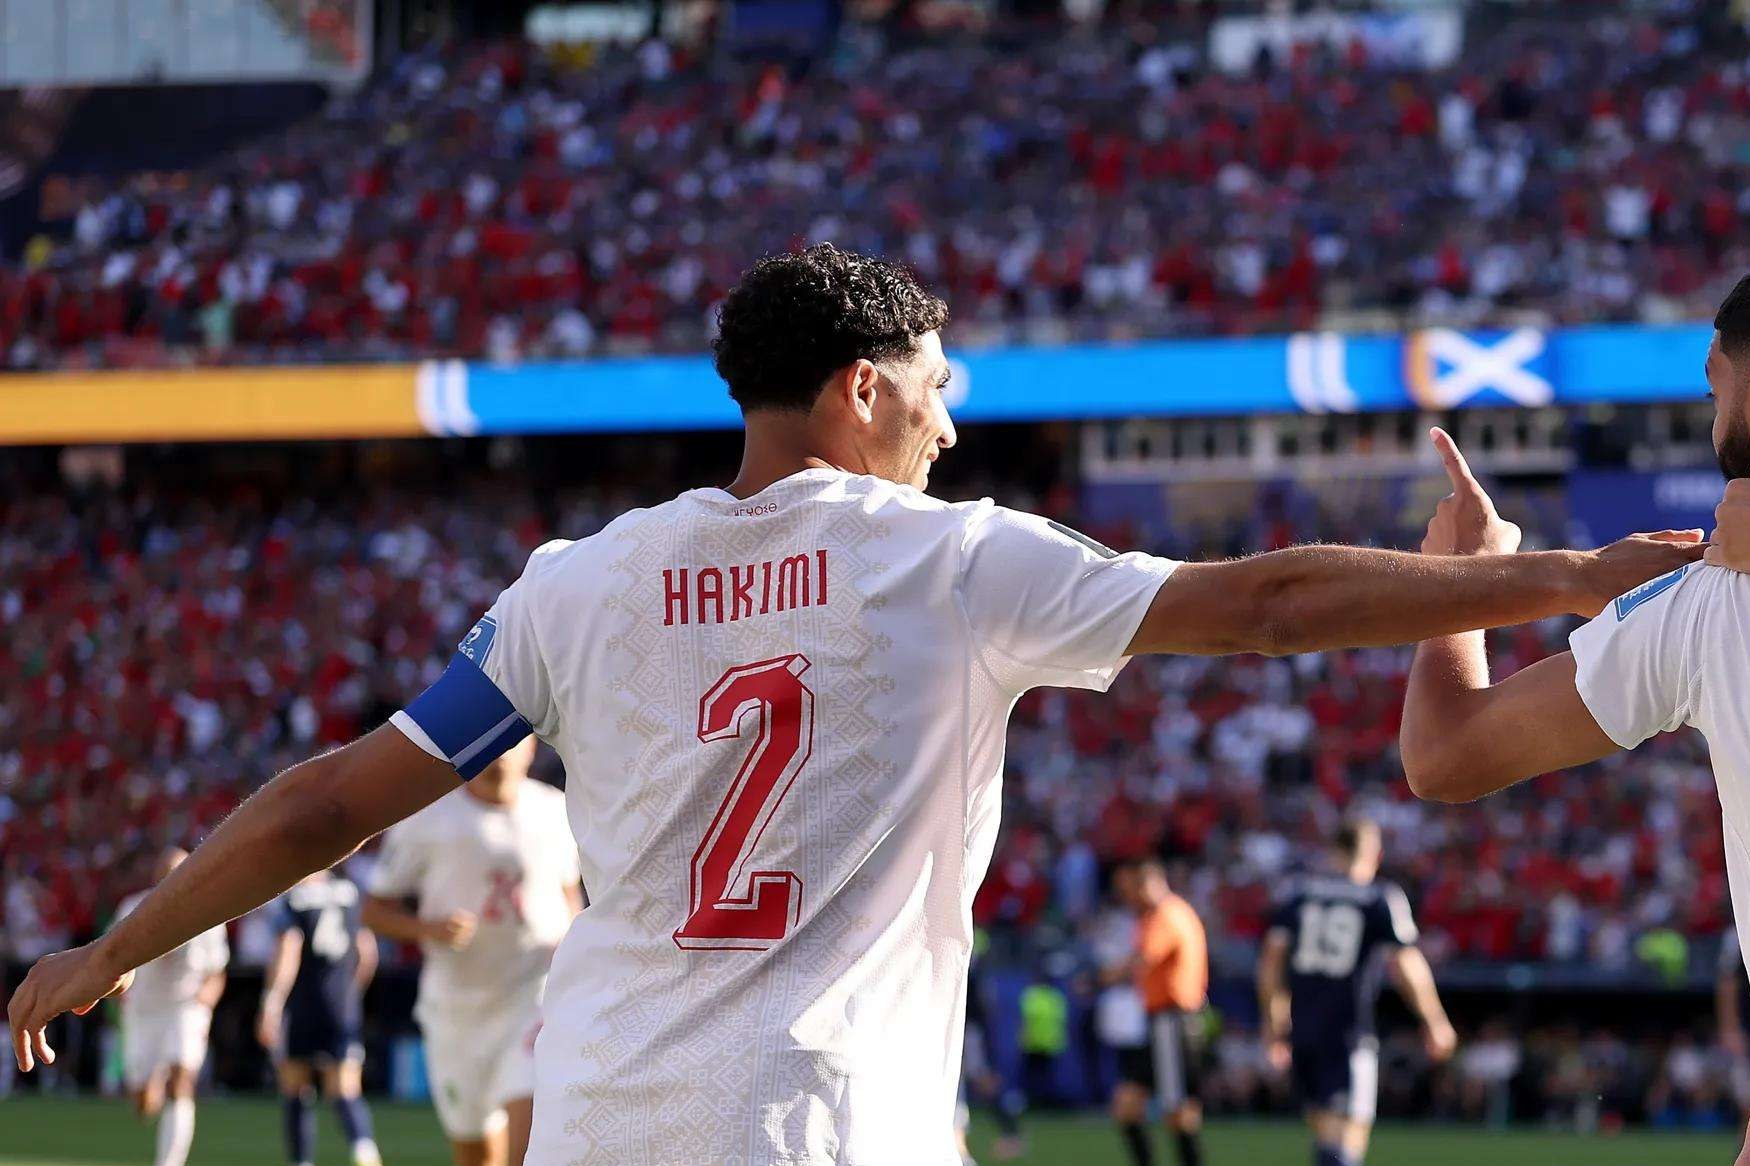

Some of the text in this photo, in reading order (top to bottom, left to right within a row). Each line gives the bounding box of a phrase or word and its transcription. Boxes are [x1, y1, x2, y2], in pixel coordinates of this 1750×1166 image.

[662, 549, 828, 627] HAKIMI
[672, 653, 815, 951] 2
[1292, 900, 1367, 979] 19
